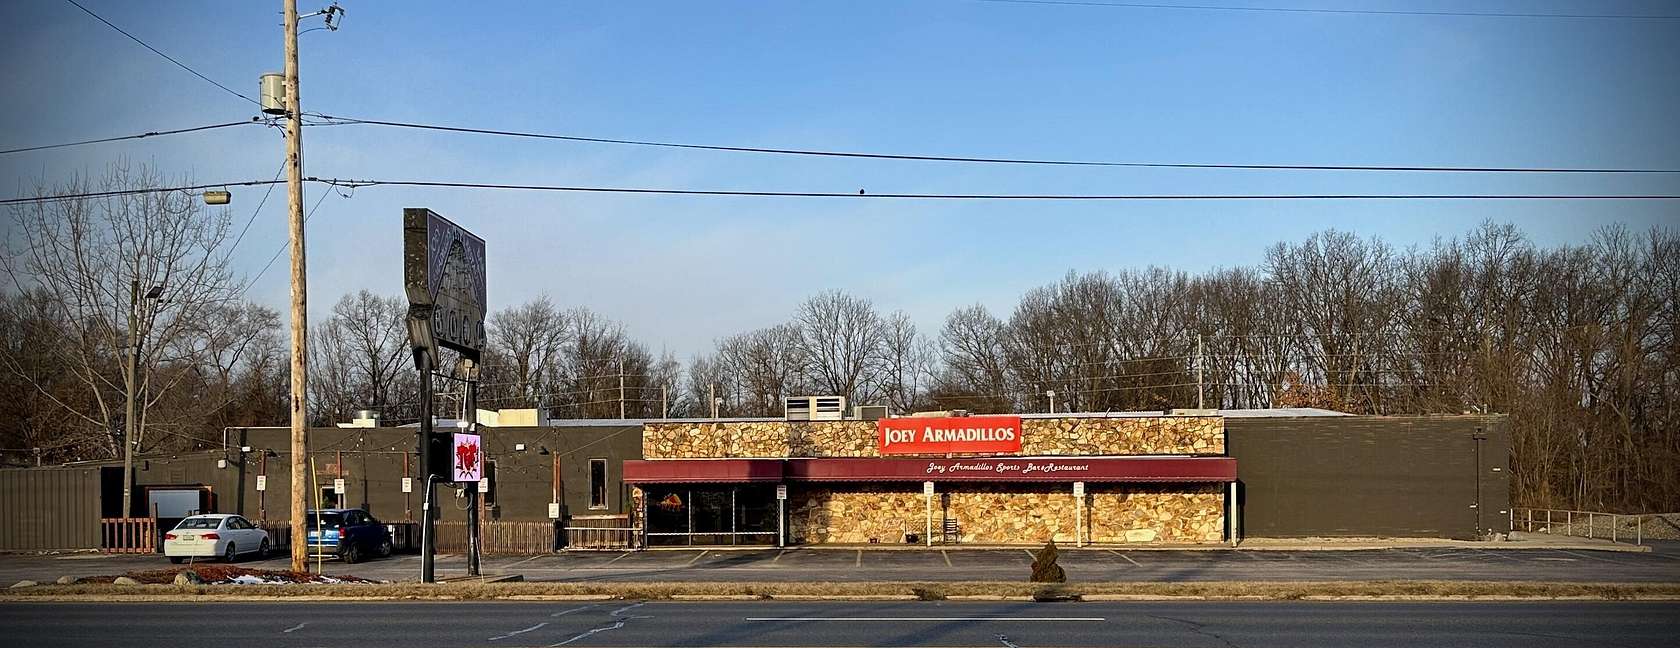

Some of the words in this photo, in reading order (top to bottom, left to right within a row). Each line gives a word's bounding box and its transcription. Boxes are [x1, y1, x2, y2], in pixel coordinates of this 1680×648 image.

[884, 427, 916, 447] JOEY
[922, 426, 1015, 443] ARMADILLOS
[926, 462, 946, 474] Joey
[948, 462, 993, 473] Armadillos
[996, 462, 1020, 475] Sports
